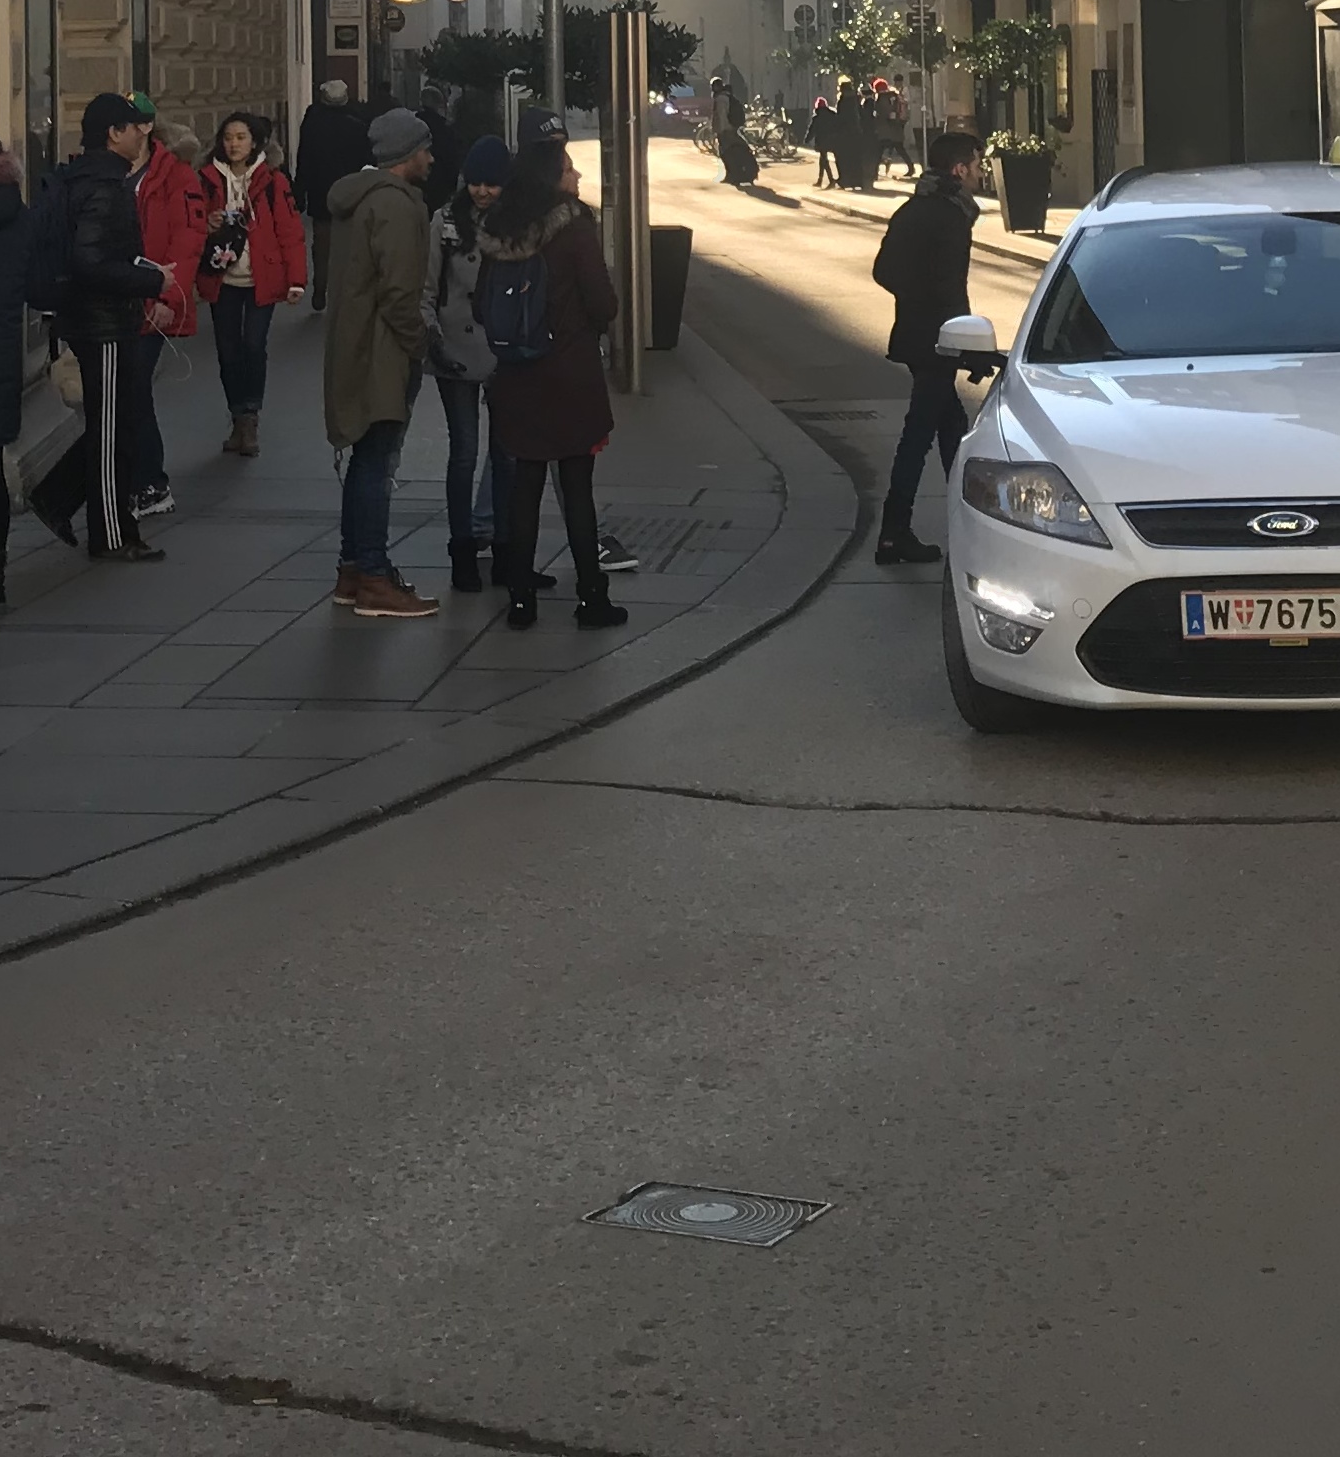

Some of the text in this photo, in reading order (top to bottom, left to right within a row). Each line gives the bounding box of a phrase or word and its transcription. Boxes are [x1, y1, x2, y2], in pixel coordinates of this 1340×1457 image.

[1266, 516, 1299, 530] Ford
[1208, 599, 1230, 630] W
[1191, 619, 1201, 630] A
